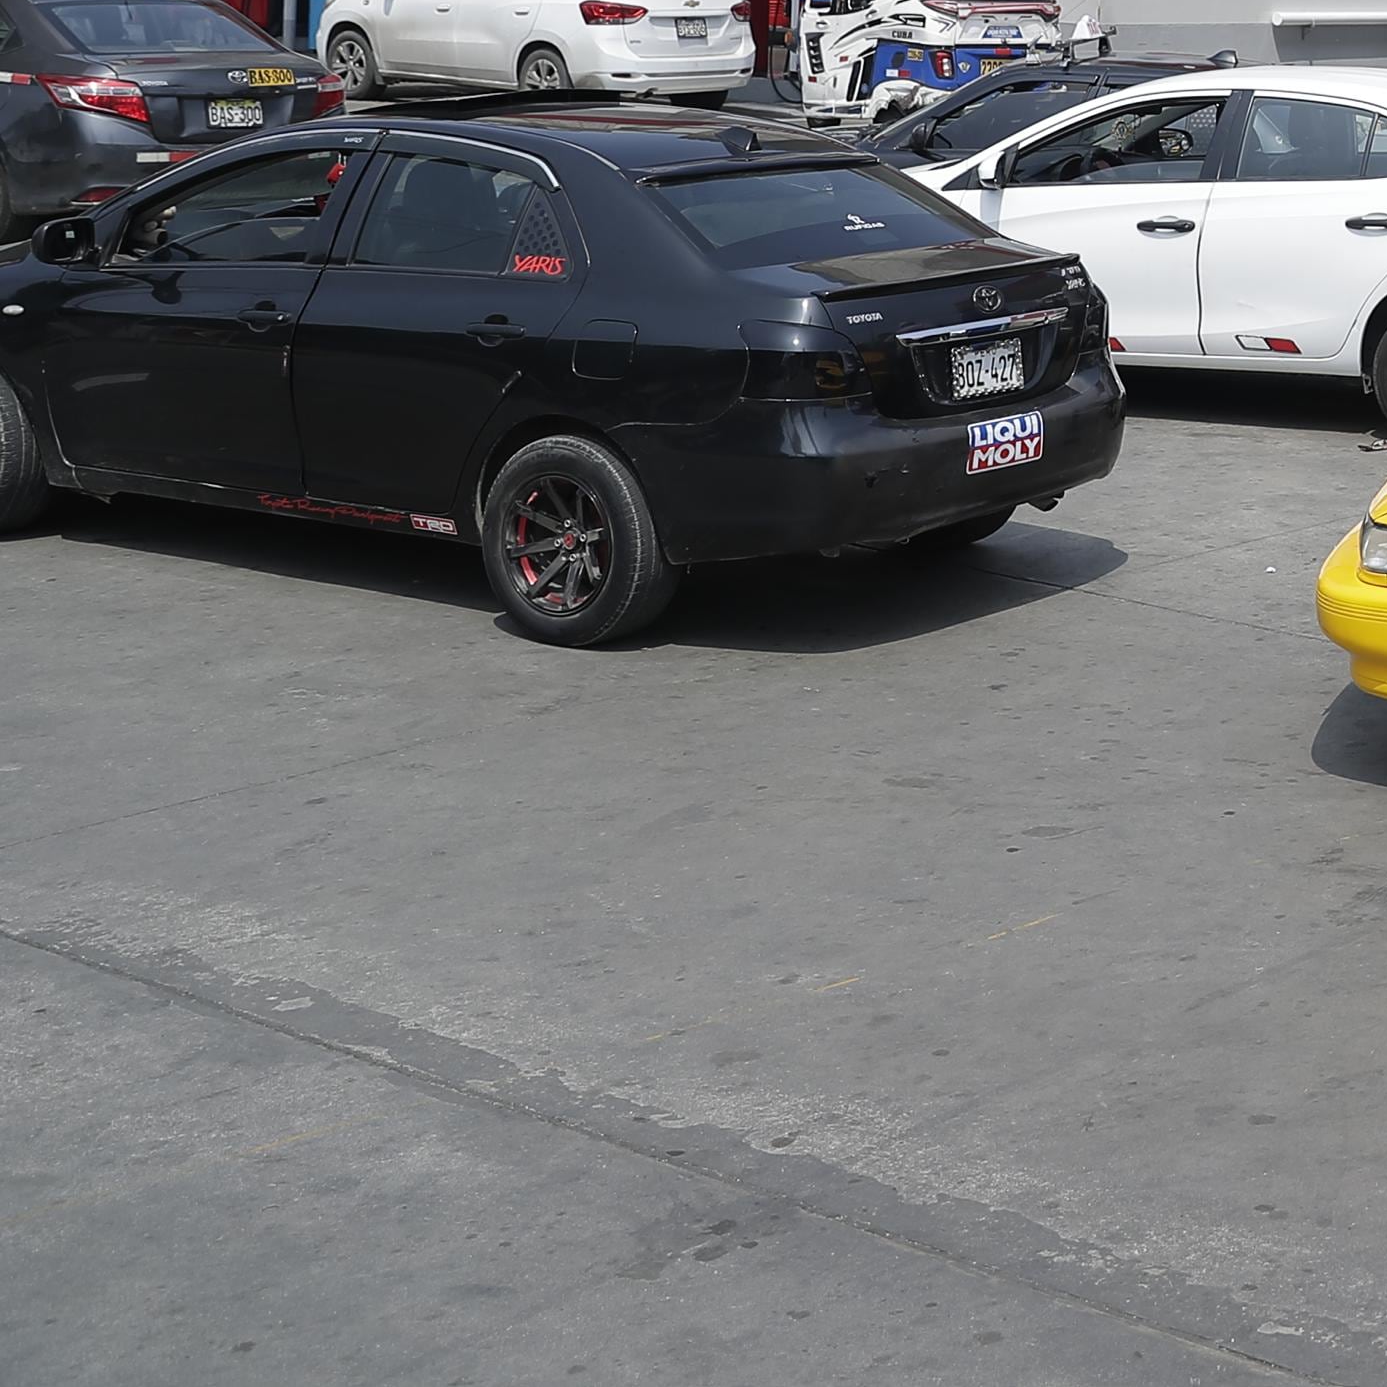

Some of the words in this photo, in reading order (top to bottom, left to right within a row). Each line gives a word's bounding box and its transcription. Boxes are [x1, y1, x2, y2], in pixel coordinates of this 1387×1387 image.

[891, 30, 913, 40] CUBA
[210, 105, 262, 123] BAS-300
[512, 254, 568, 276] YARIS
[846, 312, 884, 325] TOYOTA
[974, 414, 1039, 447] LIQUI
[972, 437, 1041, 470] MOLY
[413, 516, 455, 533] TRD
